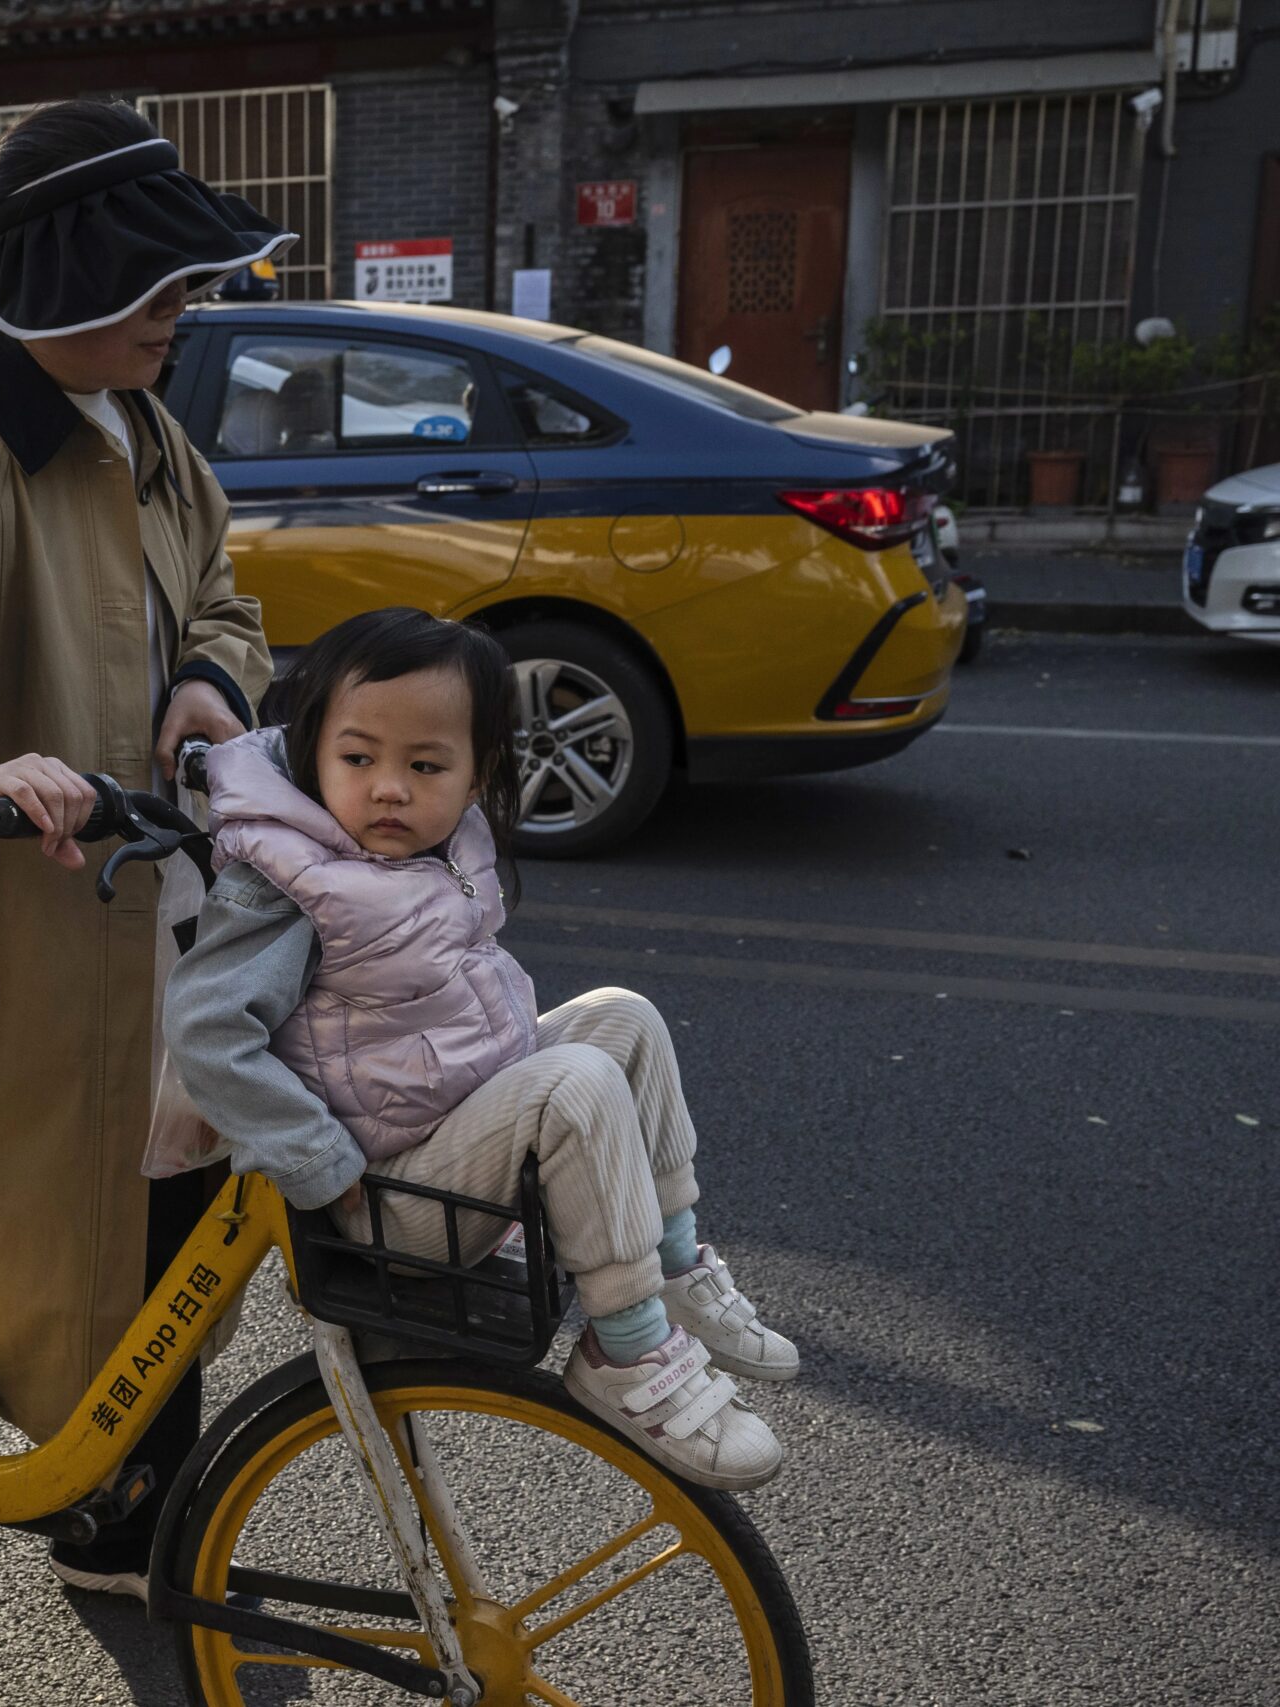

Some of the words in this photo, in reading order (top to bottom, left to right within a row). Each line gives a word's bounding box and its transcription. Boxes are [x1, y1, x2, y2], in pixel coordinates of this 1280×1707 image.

[91, 1375, 143, 1436] 美团
[131, 1323, 177, 1380] App
[168, 1263, 222, 1326] 扫码
[648, 1357, 695, 1396] BOBDOG
